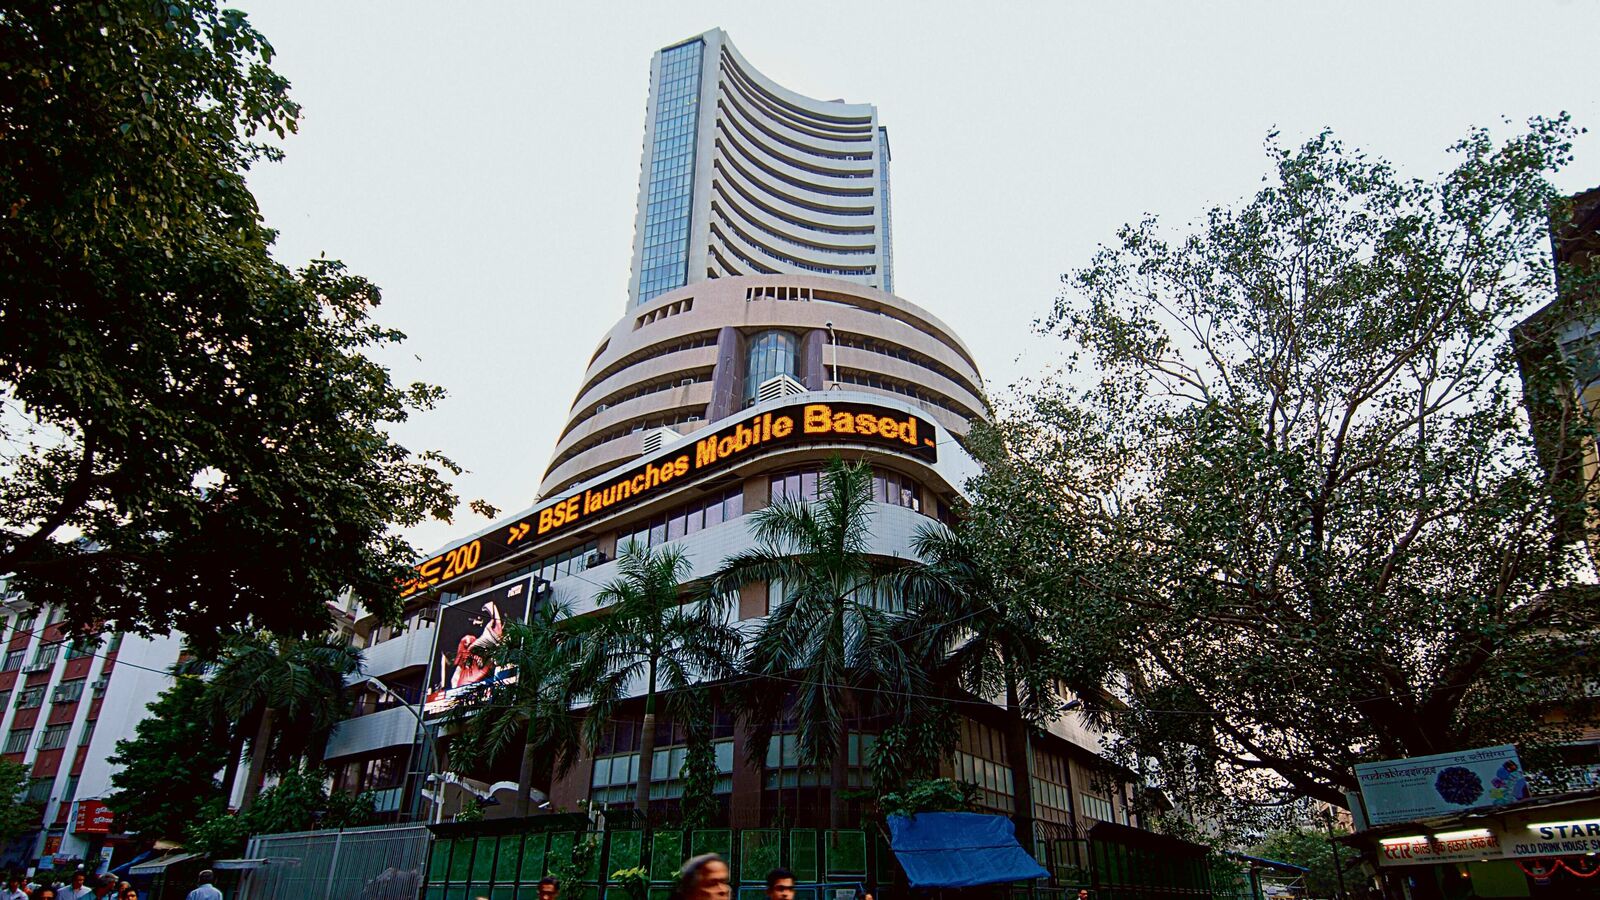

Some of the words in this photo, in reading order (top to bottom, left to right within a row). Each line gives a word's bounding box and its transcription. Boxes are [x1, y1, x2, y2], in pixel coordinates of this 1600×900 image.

[538, 494, 581, 535] BSE
[583, 460, 691, 515] launches
[695, 413, 794, 469] Mobile
[803, 404, 918, 446] Based
[442, 540, 481, 580] 200
[1540, 823, 1600, 840] STAR
[1515, 843, 1537, 855] COLD
[1537, 842, 1562, 854] DRINK
[1562, 840, 1590, 851] HOUSE
